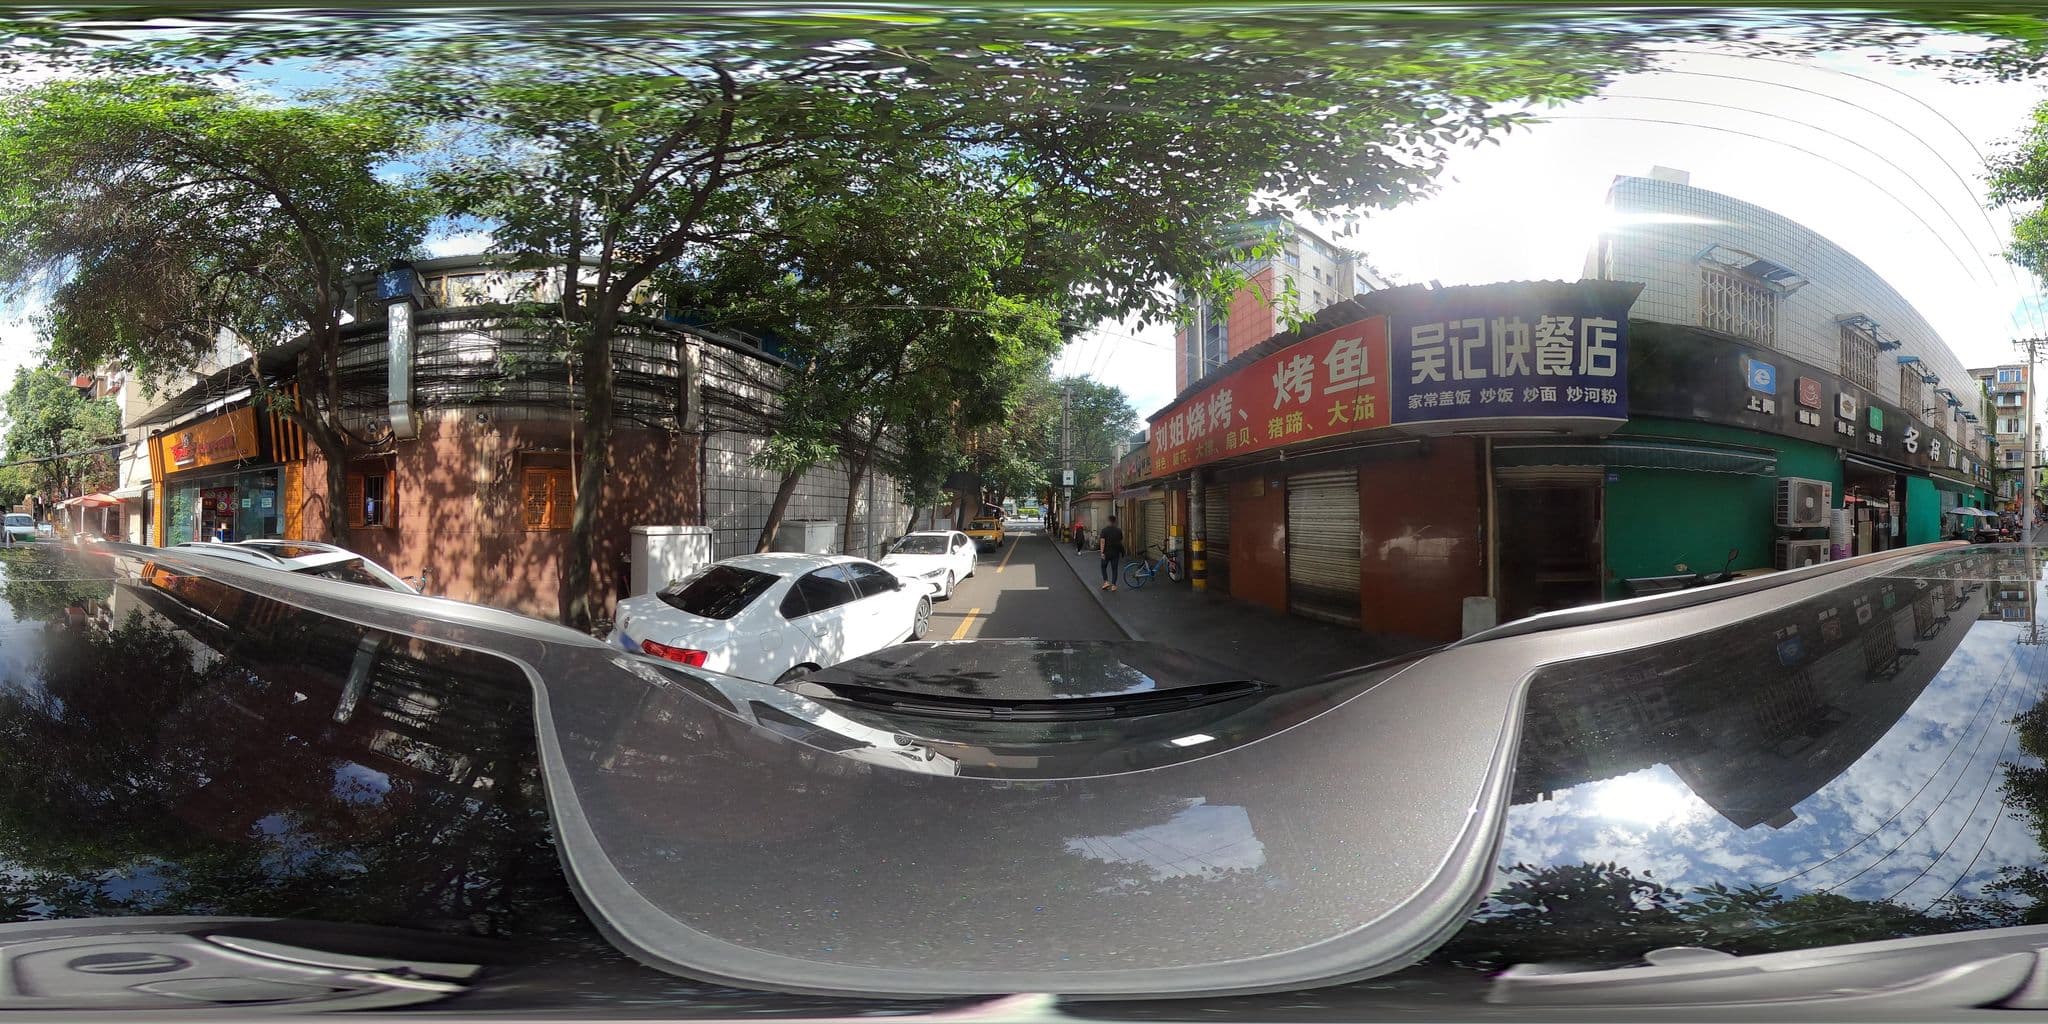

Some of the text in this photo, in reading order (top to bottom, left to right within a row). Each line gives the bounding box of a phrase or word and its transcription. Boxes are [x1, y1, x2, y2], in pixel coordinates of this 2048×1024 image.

[1411, 315, 1618, 384] 吴记快餐店
[1407, 386, 1617, 409] 家常盖饭 炒饭 炒面 炒河粉
